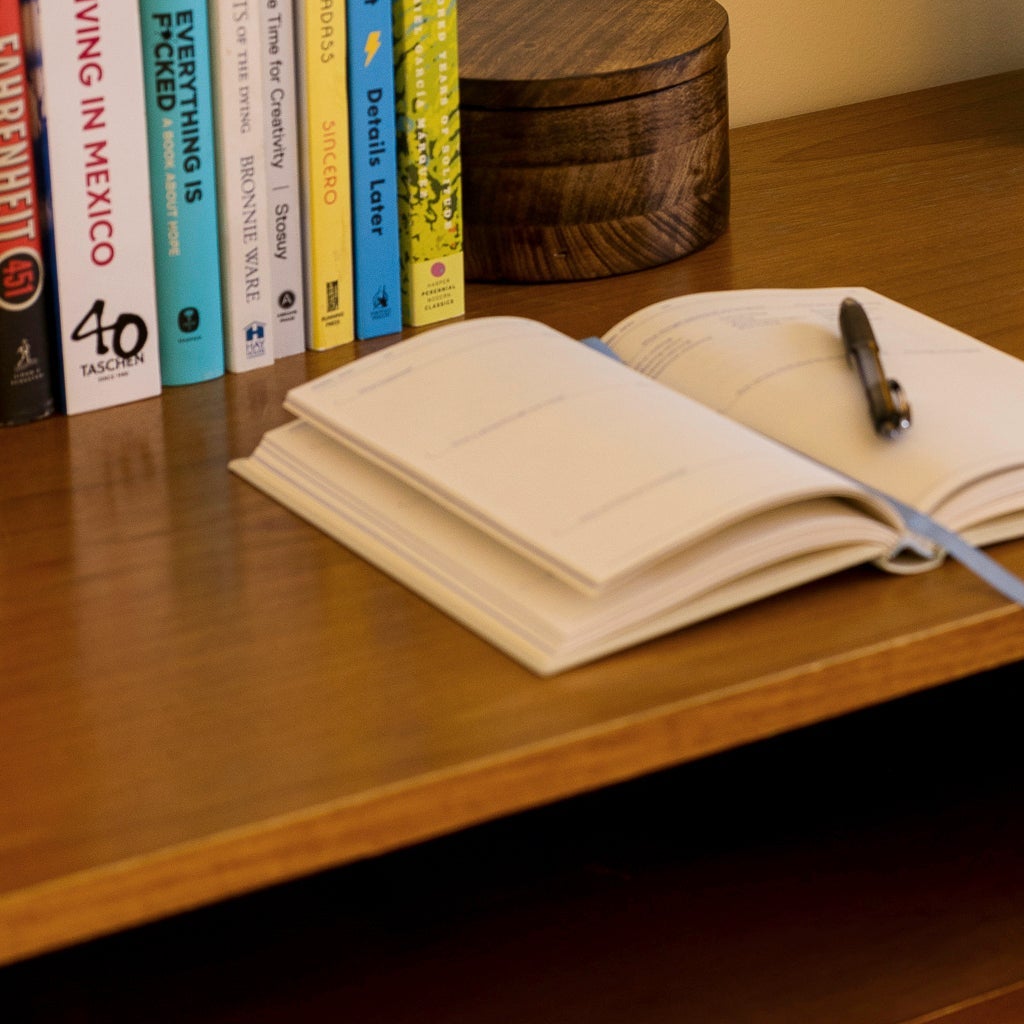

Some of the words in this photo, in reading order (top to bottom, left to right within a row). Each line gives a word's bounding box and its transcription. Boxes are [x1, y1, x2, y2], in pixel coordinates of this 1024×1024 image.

[238, 25, 248, 45] OF
[266, 12, 282, 56] Time
[175, 9, 202, 173] EVERYTHING
[238, 51, 250, 82] THE
[269, 61, 283, 84] for
[438, 51, 449, 106] YEARS
[80, 97, 106, 132] IN
[162, 117, 173, 128] A
[238, 85, 251, 135] DYING
[268, 86, 286, 170] Creativity
[366, 88, 388, 167] Details
[0, 32, 36, 241] FAHRENHEIT
[163, 130, 175, 169] BOOK
[84, 140, 116, 268] MEXICO
[184, 180, 203, 204] IS
[239, 155, 258, 246] BRONNIE
[369, 178, 386, 237] Later
[273, 204, 290, 260] Stosuy
[3, 258, 35, 298] 451
[243, 248, 261, 304] WARE
[71, 299, 148, 360] 40
[80, 353, 145, 377] TASCHEN
